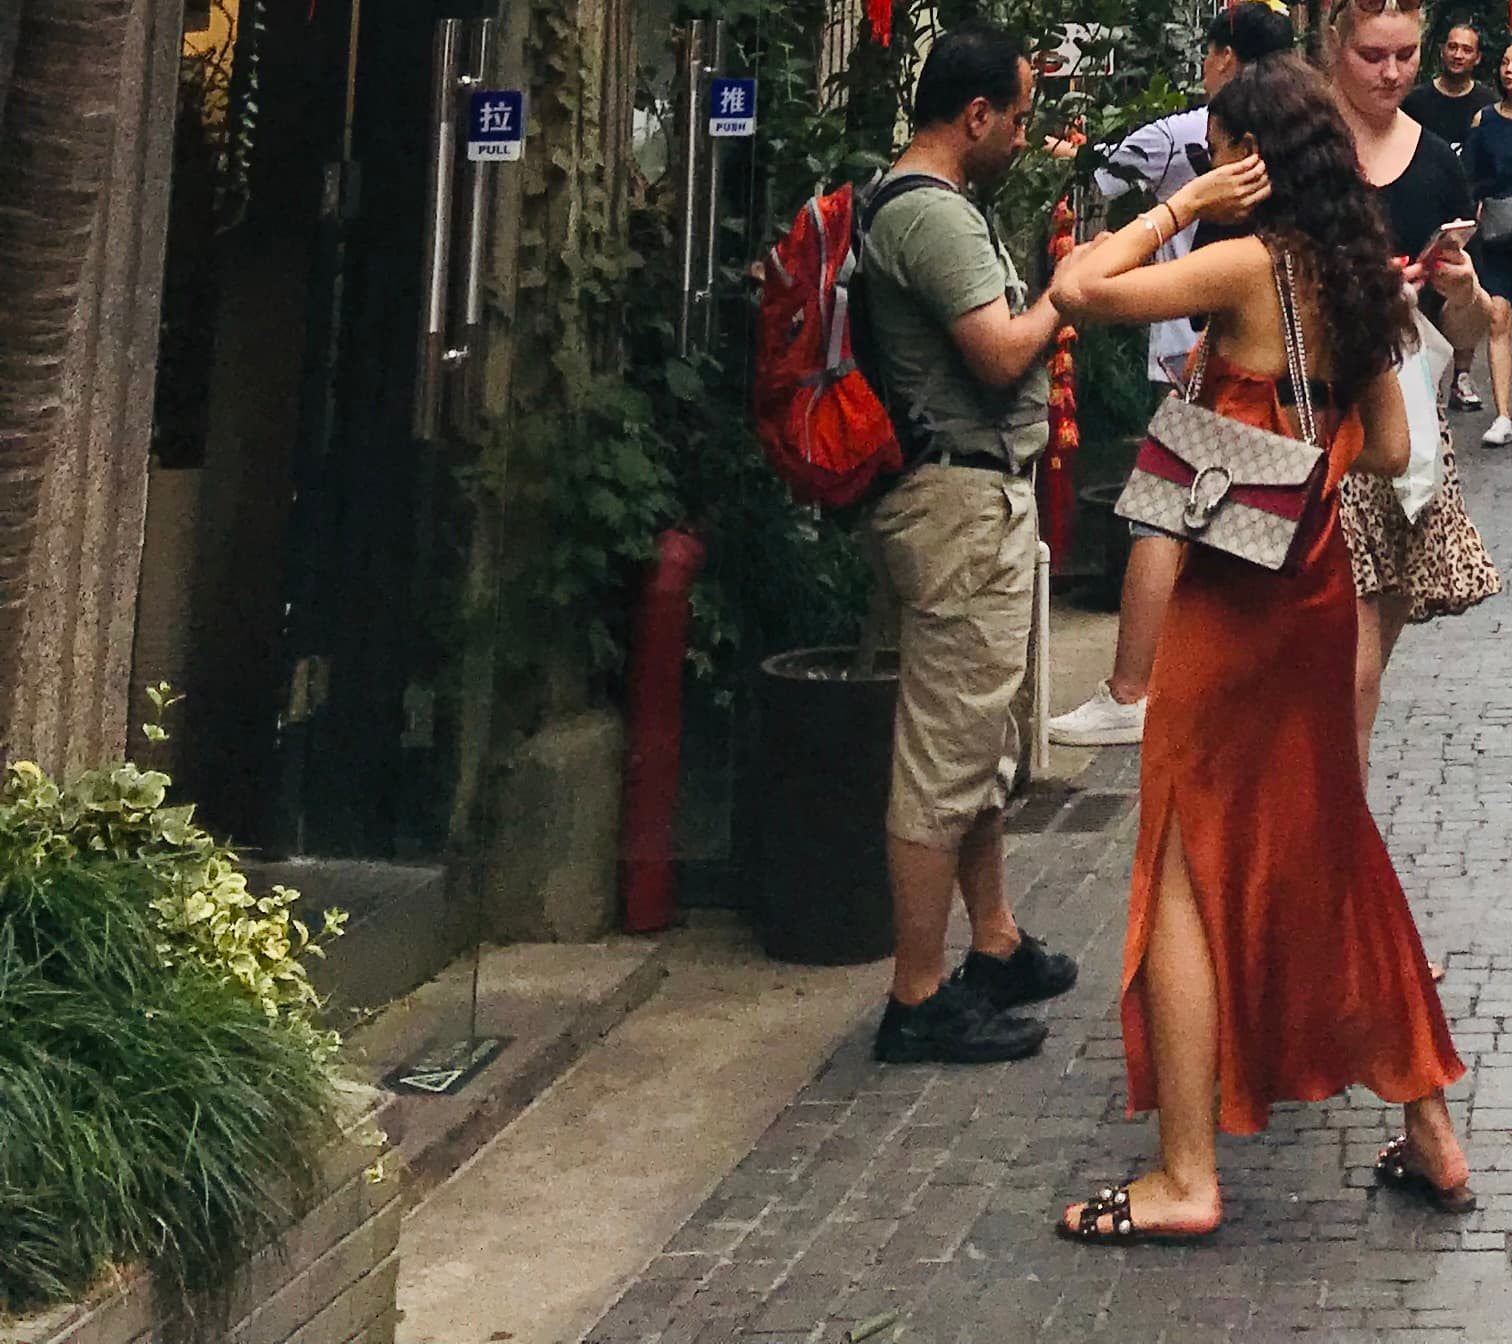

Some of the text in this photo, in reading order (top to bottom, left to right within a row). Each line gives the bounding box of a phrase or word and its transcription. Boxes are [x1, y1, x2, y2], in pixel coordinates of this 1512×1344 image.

[720, 86, 746, 114] 推
[480, 101, 513, 133] 拉
[479, 144, 511, 155] PULL
